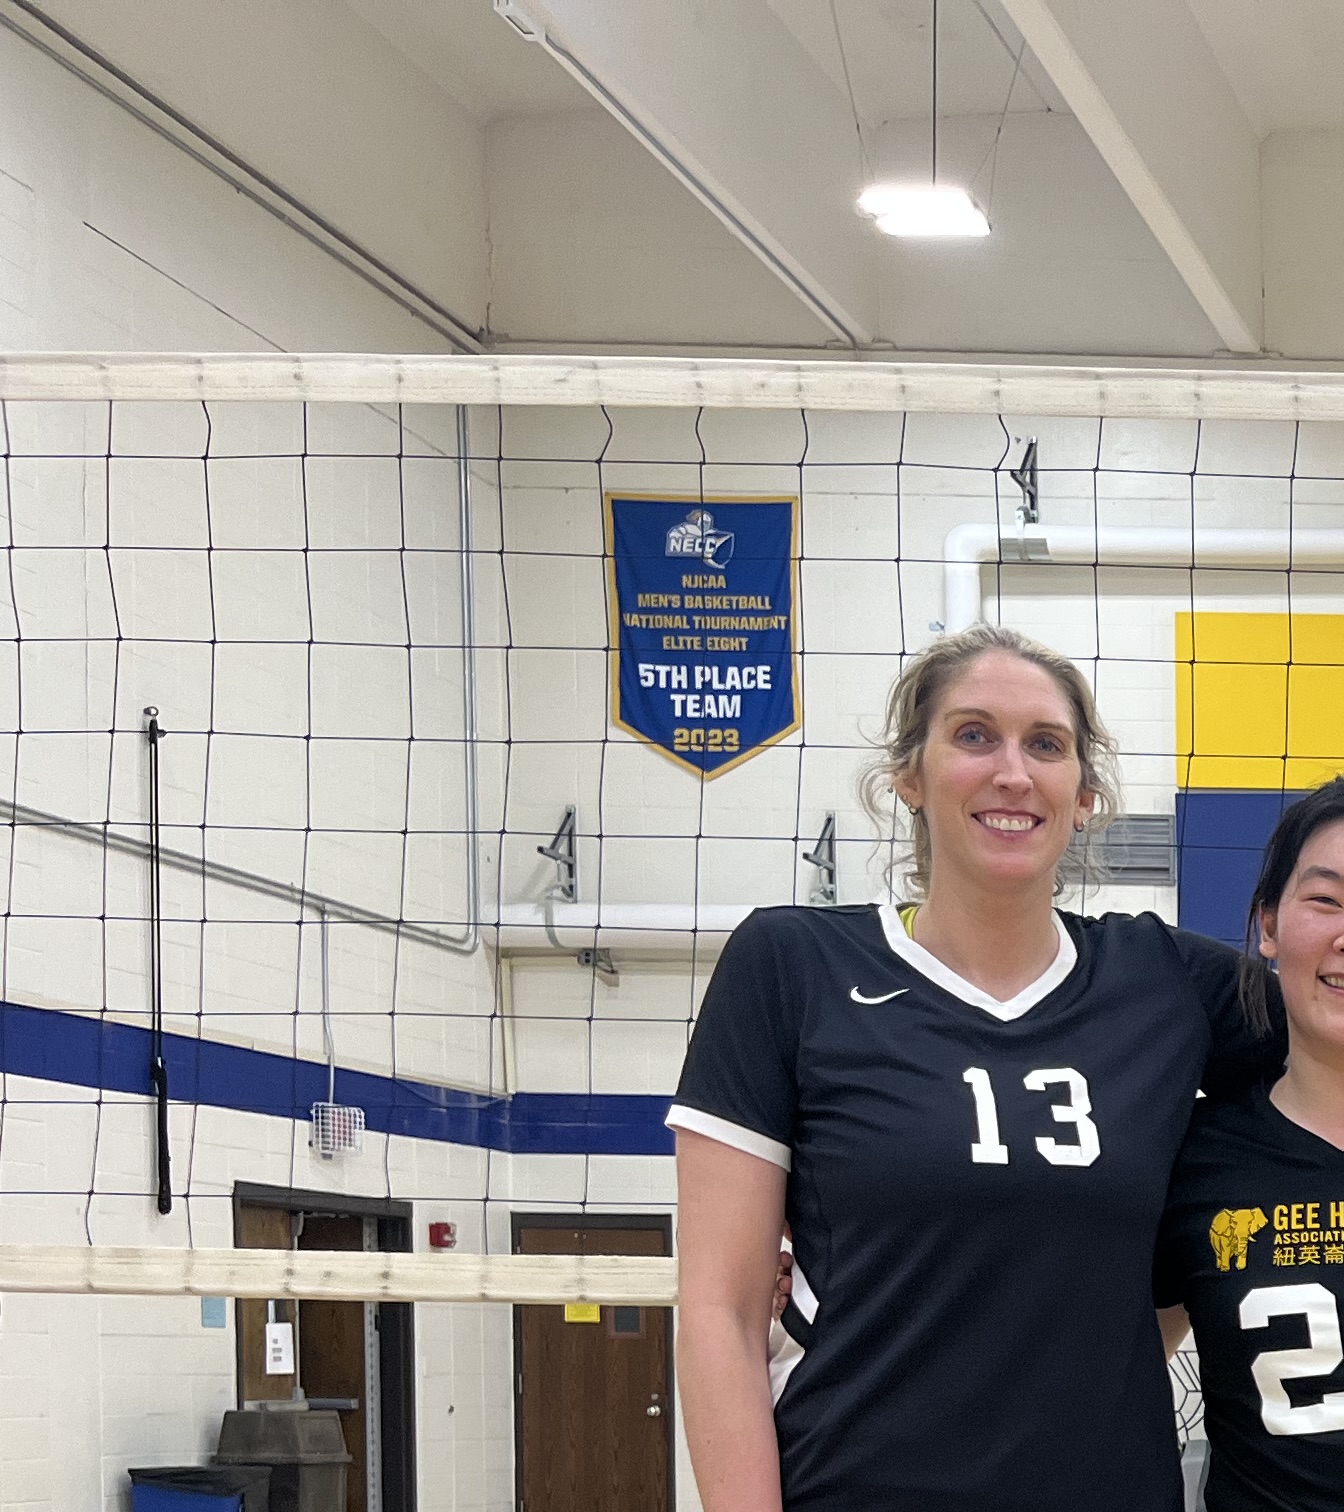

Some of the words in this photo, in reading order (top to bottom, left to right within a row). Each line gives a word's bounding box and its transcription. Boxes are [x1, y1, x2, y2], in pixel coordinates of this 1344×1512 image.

[669, 537, 717, 553] NECC
[682, 574, 726, 589] NJCAA
[637, 593, 681, 608] MEN'S
[684, 595, 772, 610] BASKETBALL
[623, 613, 690, 629] NATIONAL
[692, 615, 788, 631] TOURNAMENT
[663, 636, 700, 651] ELITE
[707, 636, 750, 651] EIGHT
[638, 663, 688, 689] 5TH
[694, 665, 772, 690] PLACE
[670, 694, 741, 718] TEAM
[673, 728, 739, 752] 2023
[962, 1067, 1101, 1167] 13
[1273, 1202, 1321, 1231] GEE
